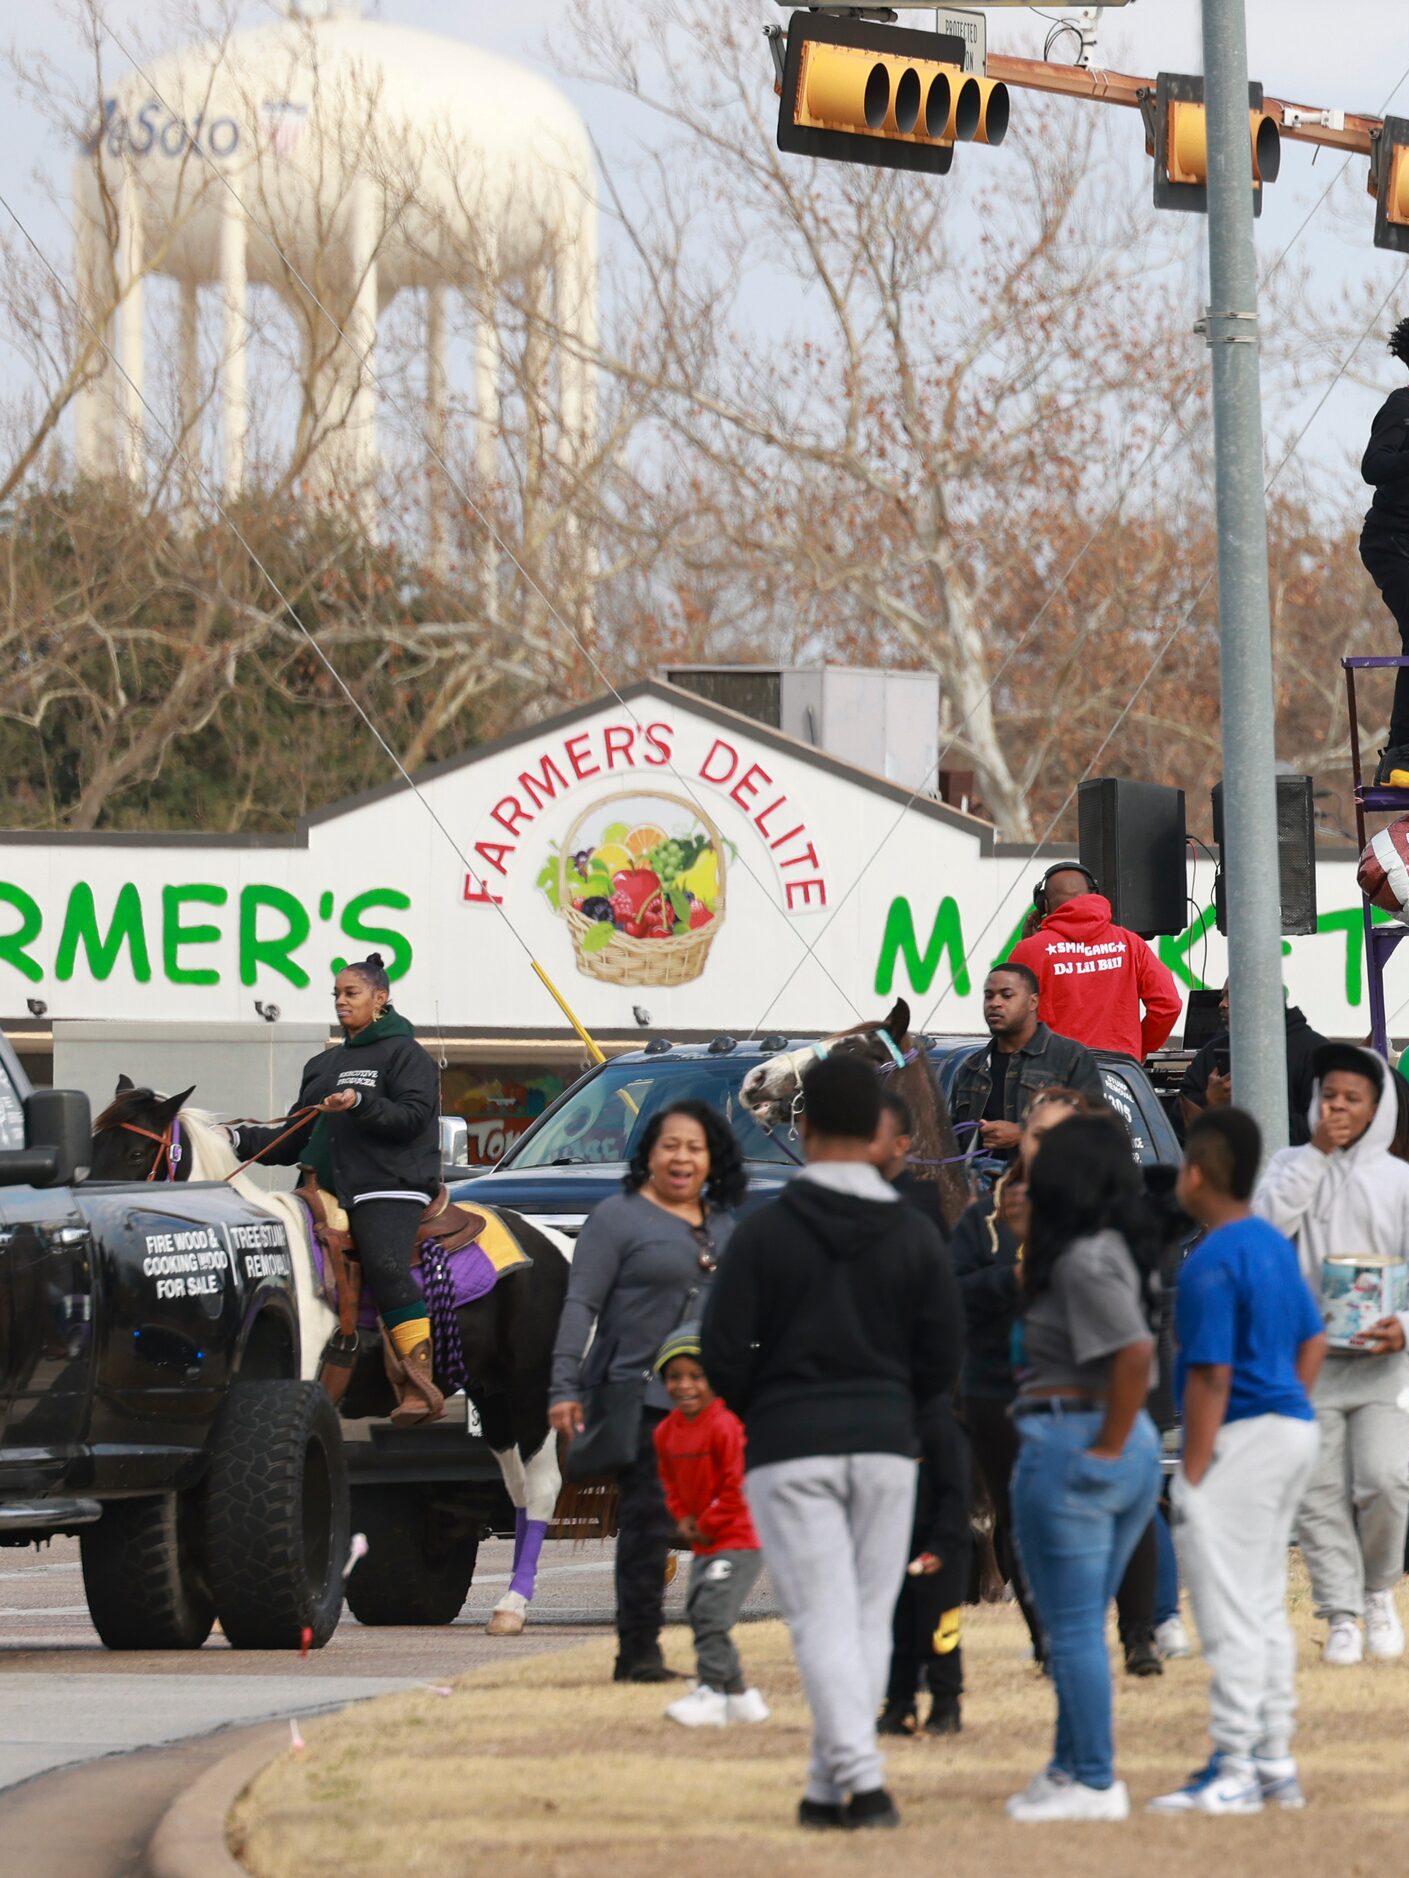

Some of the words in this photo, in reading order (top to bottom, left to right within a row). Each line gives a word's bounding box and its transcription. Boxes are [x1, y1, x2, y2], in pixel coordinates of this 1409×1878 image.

[463, 722, 675, 905] FARMER'S
[699, 739, 827, 910] DELITE
[875, 895, 1394, 1006] MKT
[1053, 962, 1074, 975] DJ
[1076, 961, 1096, 974] Lil
[1097, 956, 1122, 971] Bill
[145, 1233, 174, 1254] FIRE
[173, 1230, 208, 1251] WOOD
[207, 1228, 219, 1248] &
[230, 1225, 261, 1249] TREE
[143, 1253, 198, 1277] COOKING
[197, 1250, 228, 1271] WOOD
[156, 1277, 186, 1299] FOR
[187, 1275, 219, 1296] SALE
